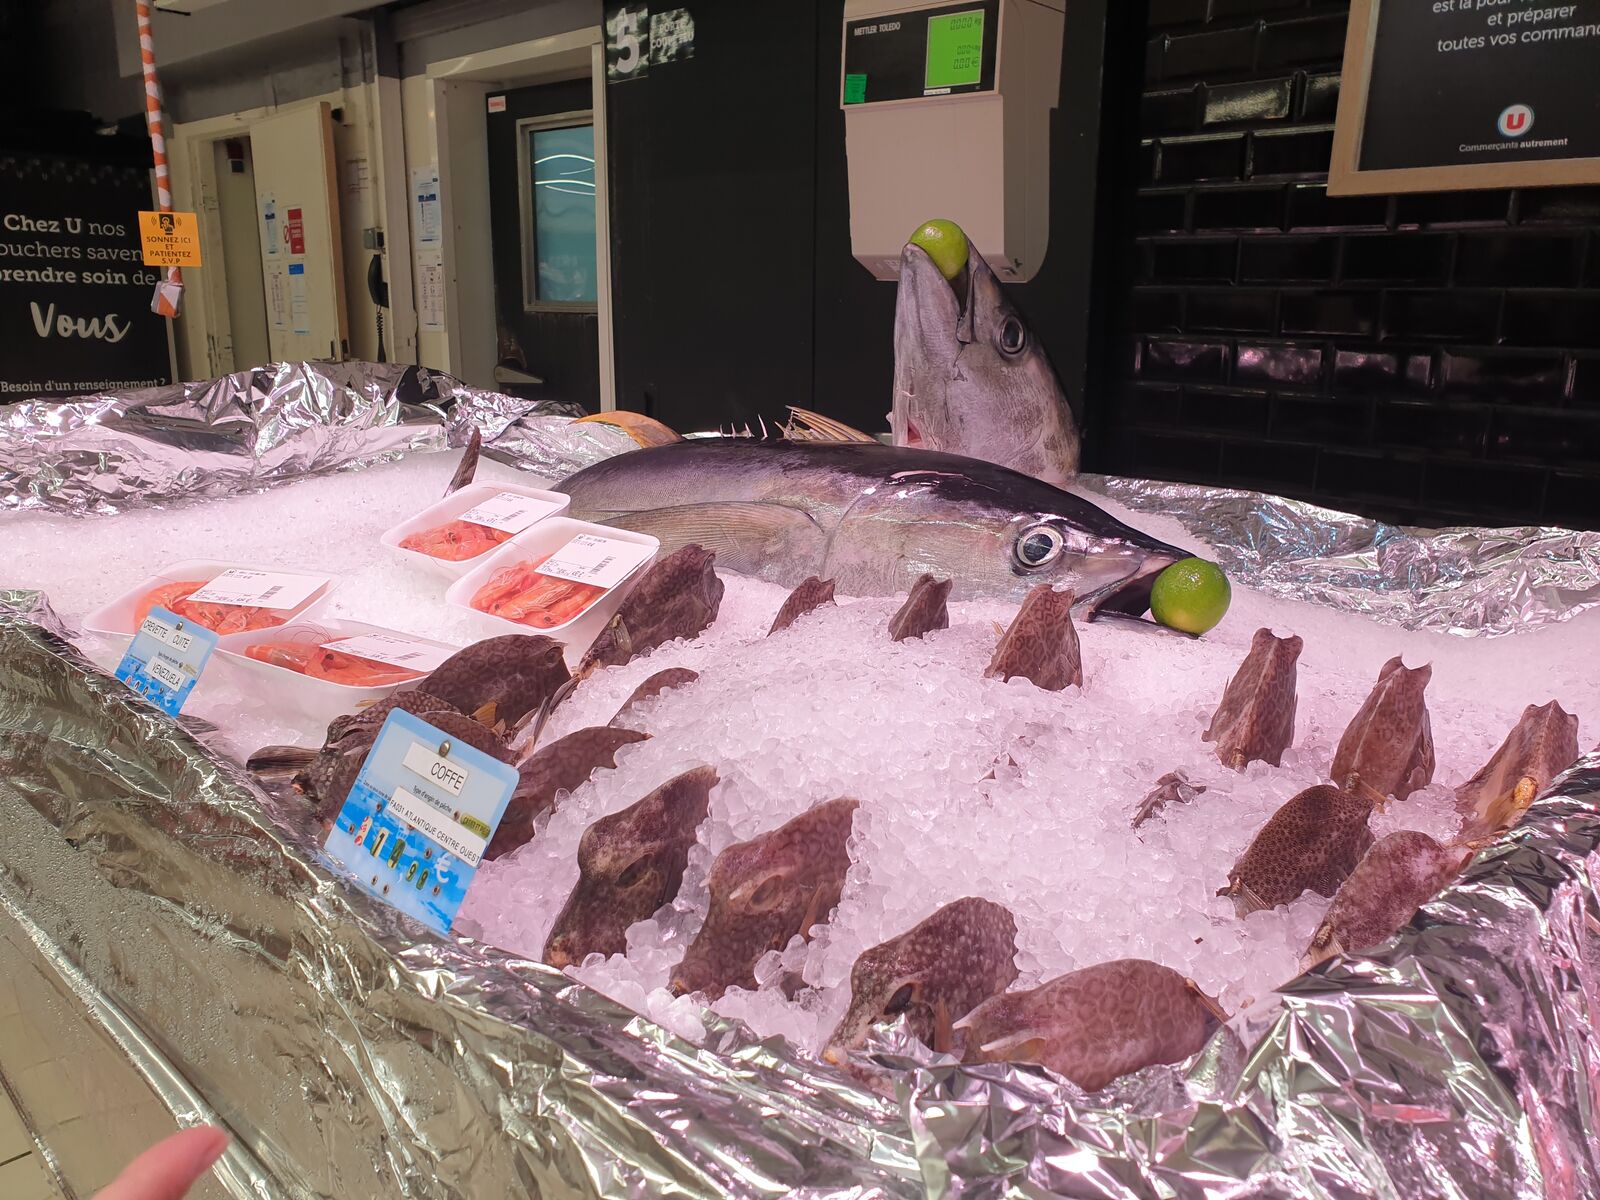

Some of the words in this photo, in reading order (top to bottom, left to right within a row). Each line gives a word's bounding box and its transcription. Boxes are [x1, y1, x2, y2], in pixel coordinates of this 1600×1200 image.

[1432, 0, 1453, 13] est
[1487, 13, 1502, 26] et
[1507, 5, 1577, 27] préparer
[854, 25, 878, 36] METTLER
[879, 21, 900, 32] TOLEDO
[616, 12, 640, 73] 5
[1437, 36, 1485, 52] toutes
[1490, 32, 1517, 46] vos
[1506, 112, 1525, 130] U
[1459, 141, 1518, 153] Commerçants
[1520, 138, 1568, 149] autrement
[4, 214, 60, 233] Chez
[65, 217, 82, 234] U
[88, 222, 126, 237] nos
[0, 241, 80, 259] ouchers
[87, 247, 143, 261] saven
[82, 269, 128, 284] soin
[132, 271, 156, 286] de
[30, 301, 131, 343] Vous
[1, 380, 42, 393] Besoin
[44, 379, 71, 391] d'un
[74, 378, 158, 390] renseignement
[143, 620, 168, 638] CREVETTE
[172, 634, 190, 649] CUITE
[152, 662, 182, 686] VENEZUELA
[431, 762, 464, 790] COFFE
[404, 810, 436, 836] ATLANTIQUE
[436, 831, 460, 851] CENTRE
[460, 845, 480, 864] OUEST
